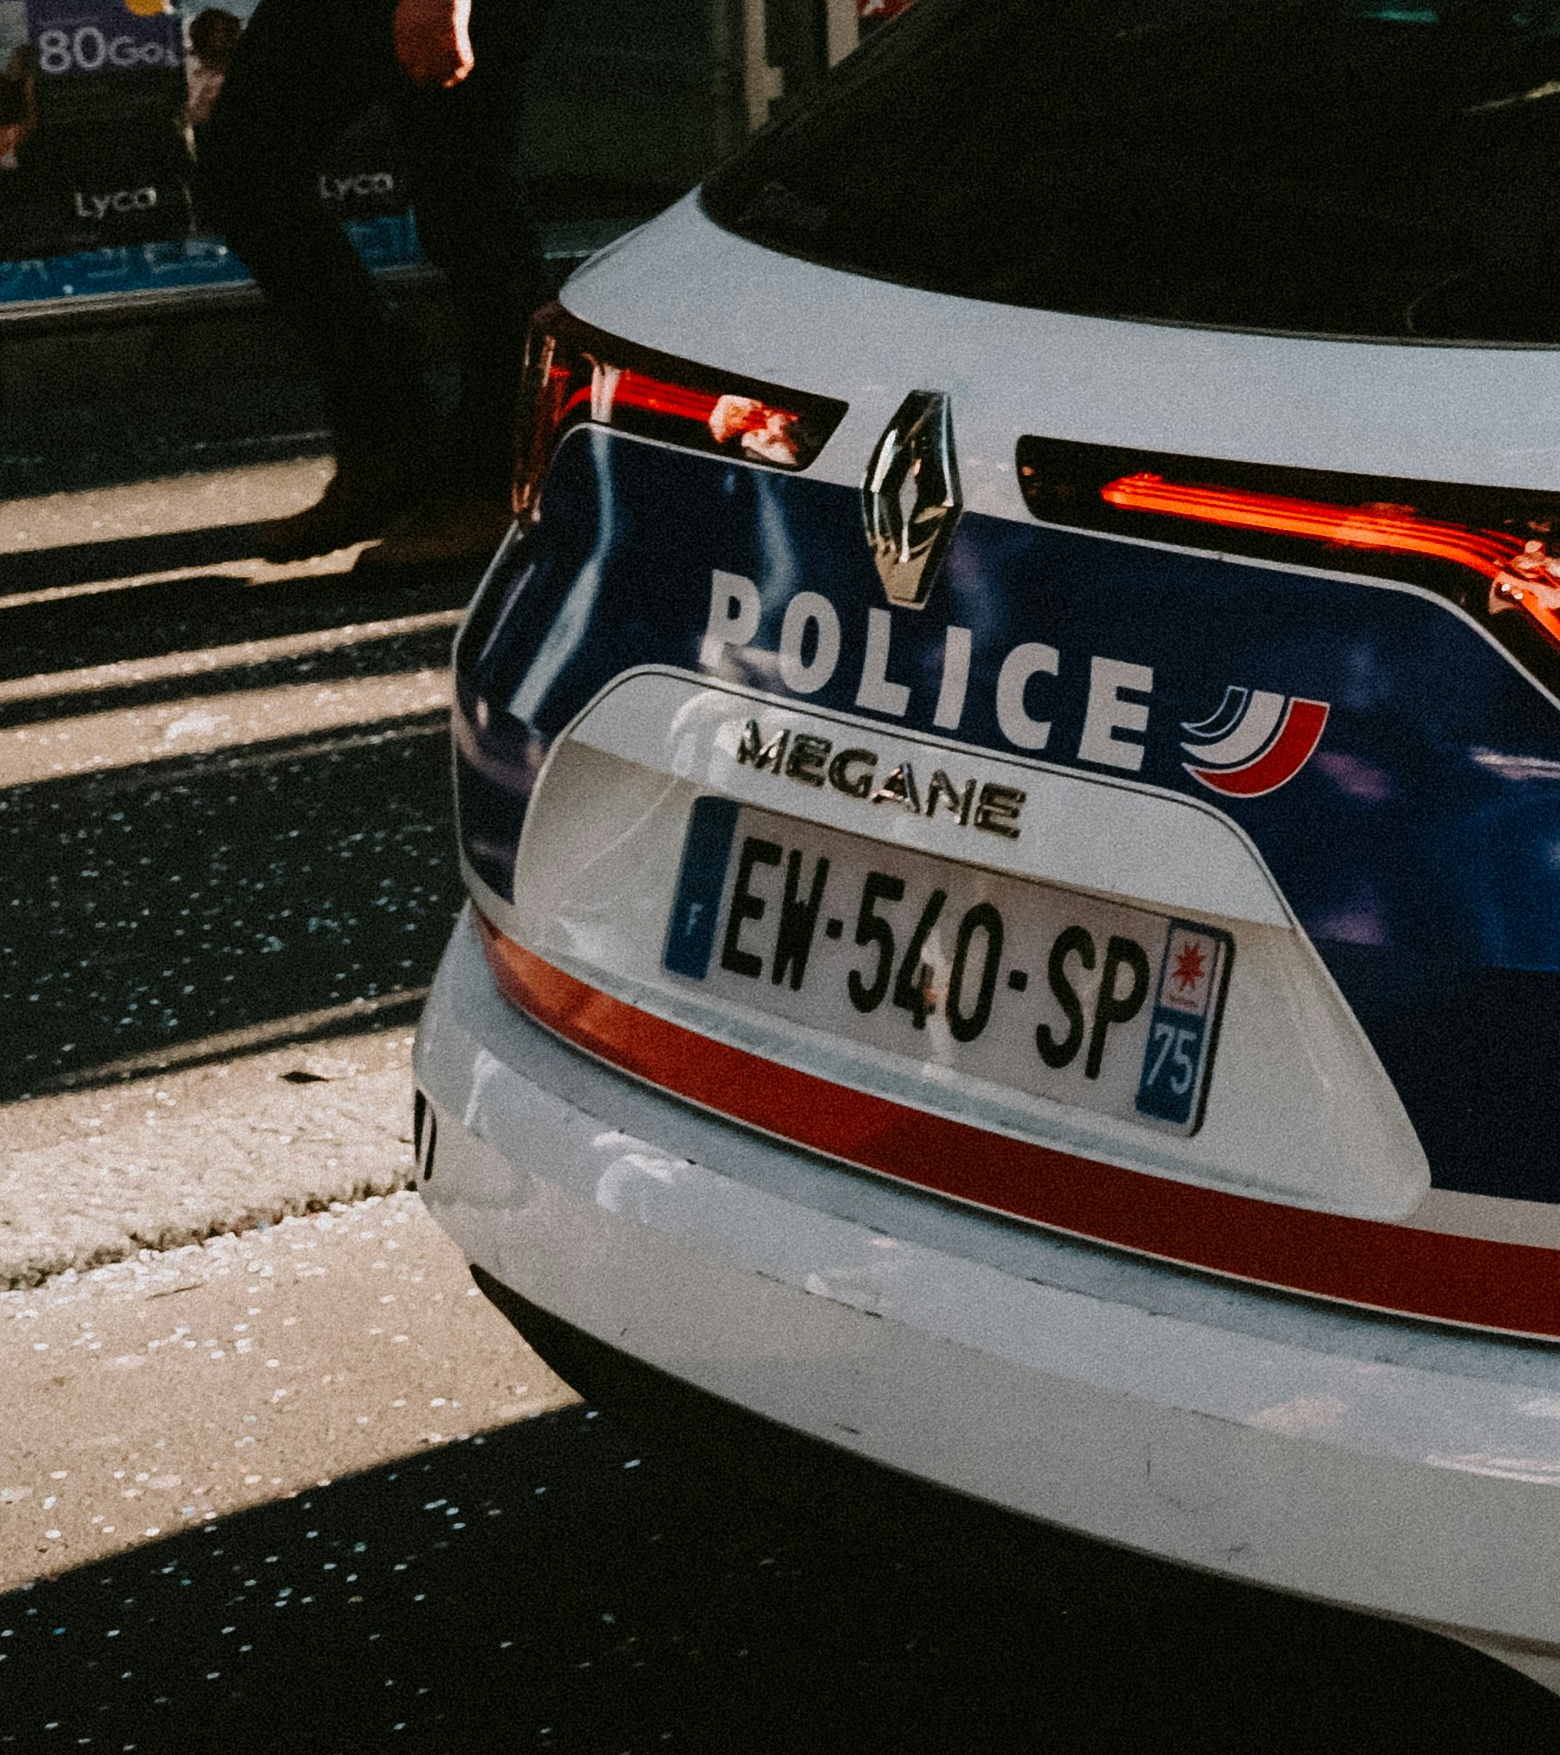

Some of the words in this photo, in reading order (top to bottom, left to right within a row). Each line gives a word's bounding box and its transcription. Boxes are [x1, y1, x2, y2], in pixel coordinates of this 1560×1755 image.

[700, 568, 1156, 775] POLICE
[736, 716, 1030, 842] MEGANE
[684, 902, 706, 938] F
[720, 835, 1151, 1081] EW-540-SP
[1146, 1021, 1198, 1096] 75
